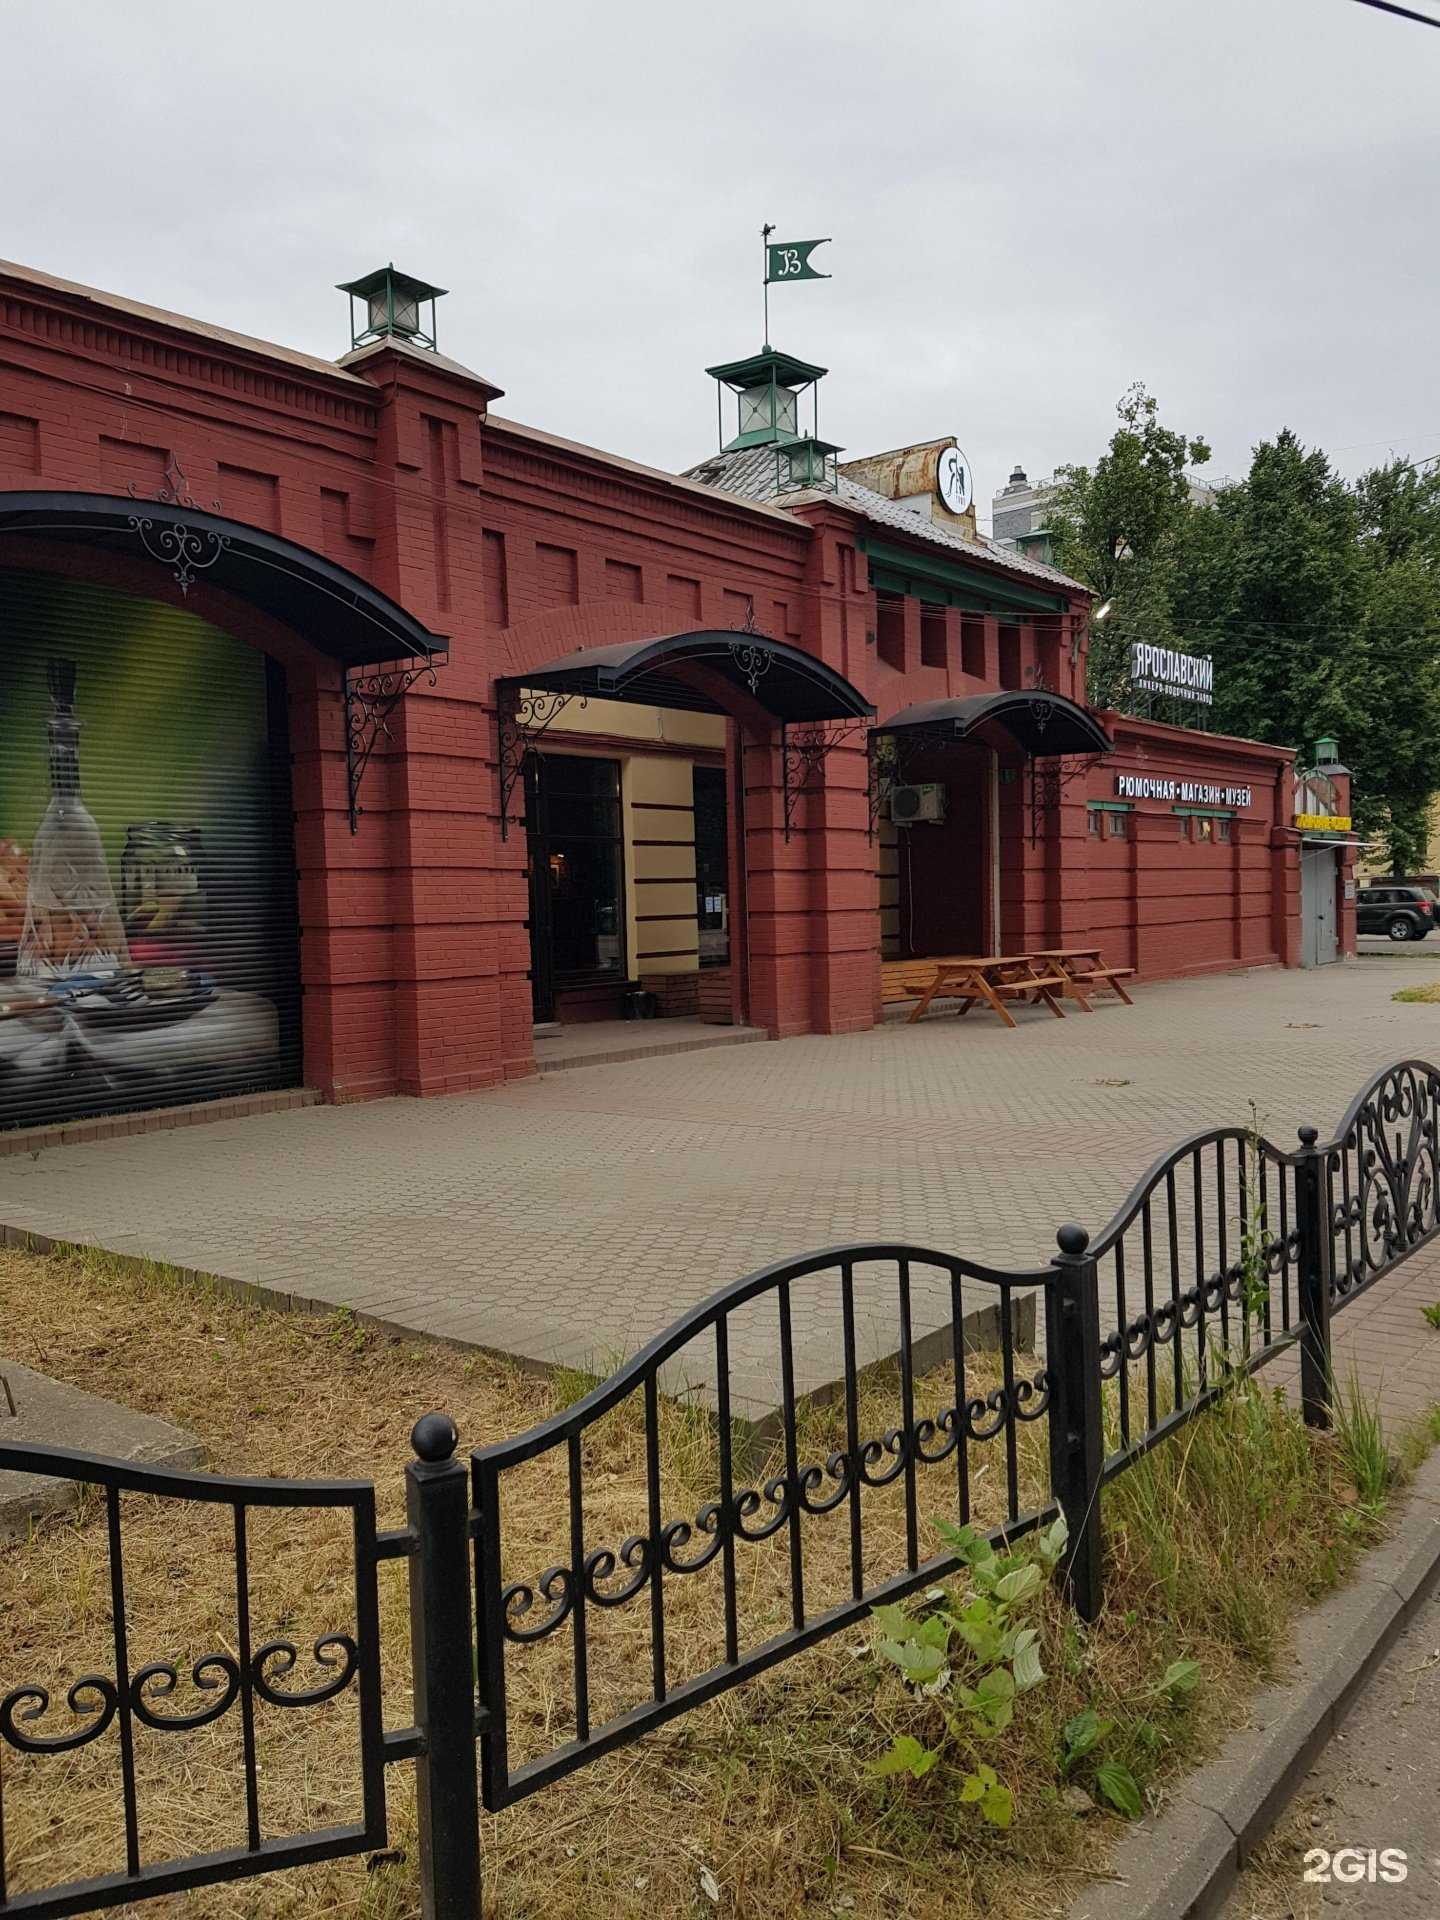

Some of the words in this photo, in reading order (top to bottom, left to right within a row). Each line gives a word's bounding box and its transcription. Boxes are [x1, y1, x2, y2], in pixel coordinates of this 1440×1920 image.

[1134, 643, 1212, 691] ЯРОСЛАВСКИЙ
[1118, 775, 1175, 800] РЮМОЧНАЯ
[1181, 782, 1221, 804] МАГАЗИН
[1225, 785, 1252, 807] МУЗЕЙ
